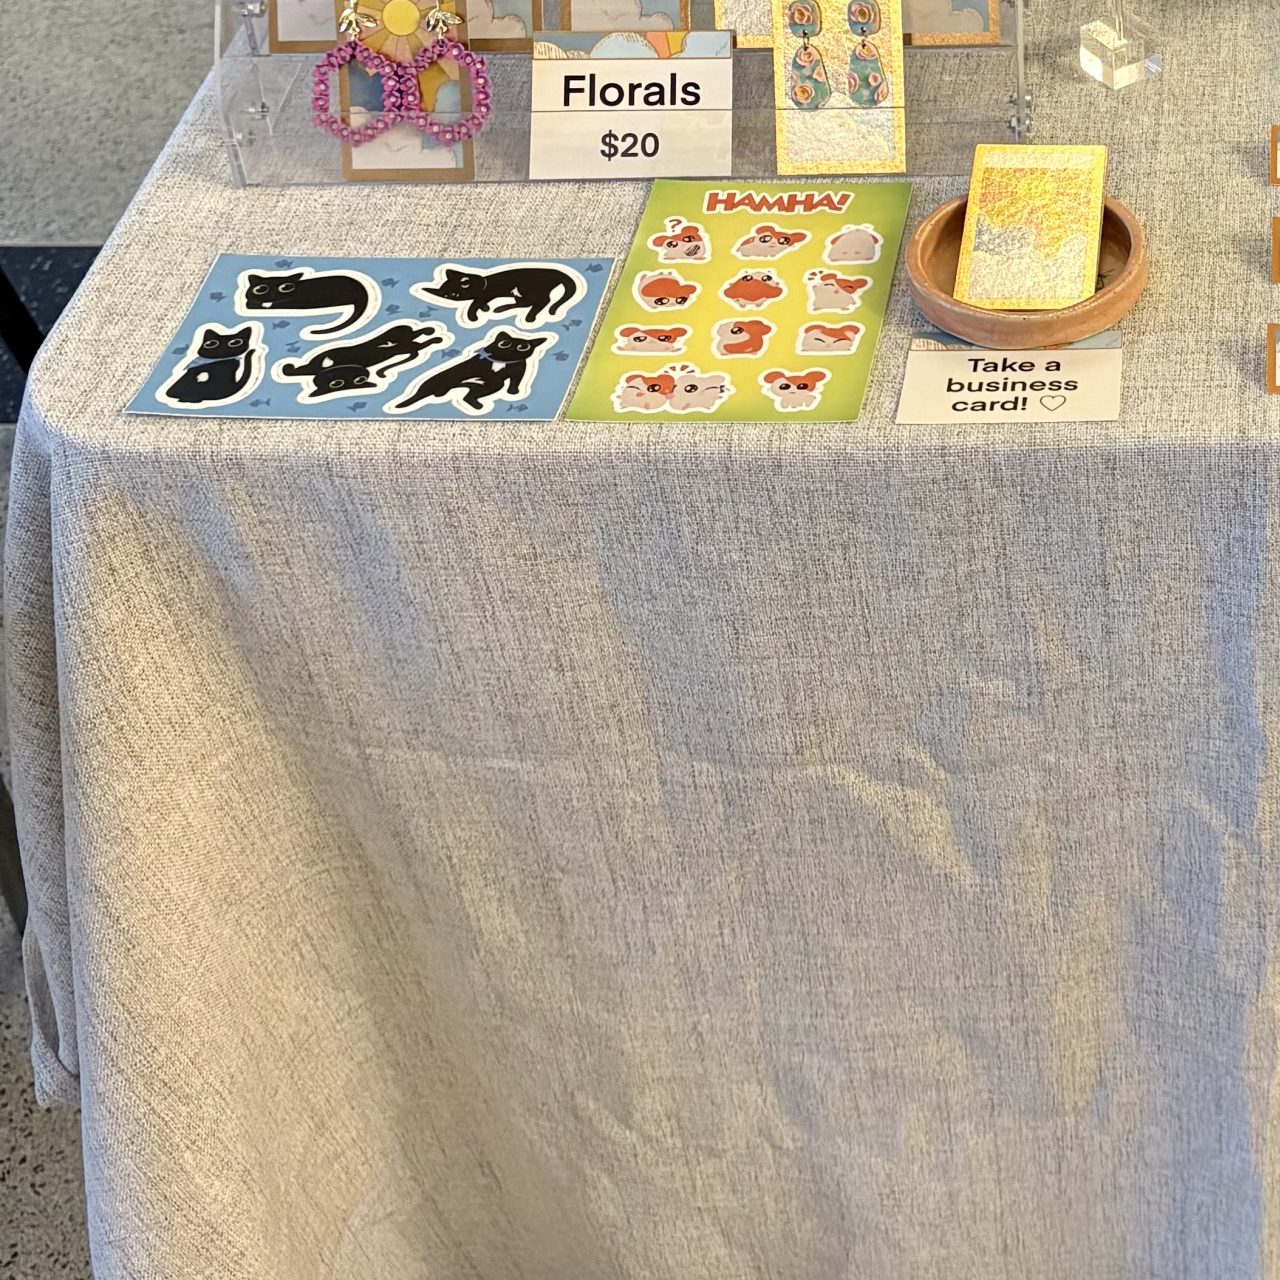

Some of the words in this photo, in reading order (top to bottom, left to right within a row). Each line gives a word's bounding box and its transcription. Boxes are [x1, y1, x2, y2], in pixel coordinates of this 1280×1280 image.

[563, 73, 701, 107] Florals
[600, 130, 660, 162] $20
[705, 191, 852, 213] HAMHA!
[968, 358, 1035, 372] Take
[1045, 361, 1061, 372] a
[946, 378, 1078, 392] business
[952, 396, 1028, 411] card!
